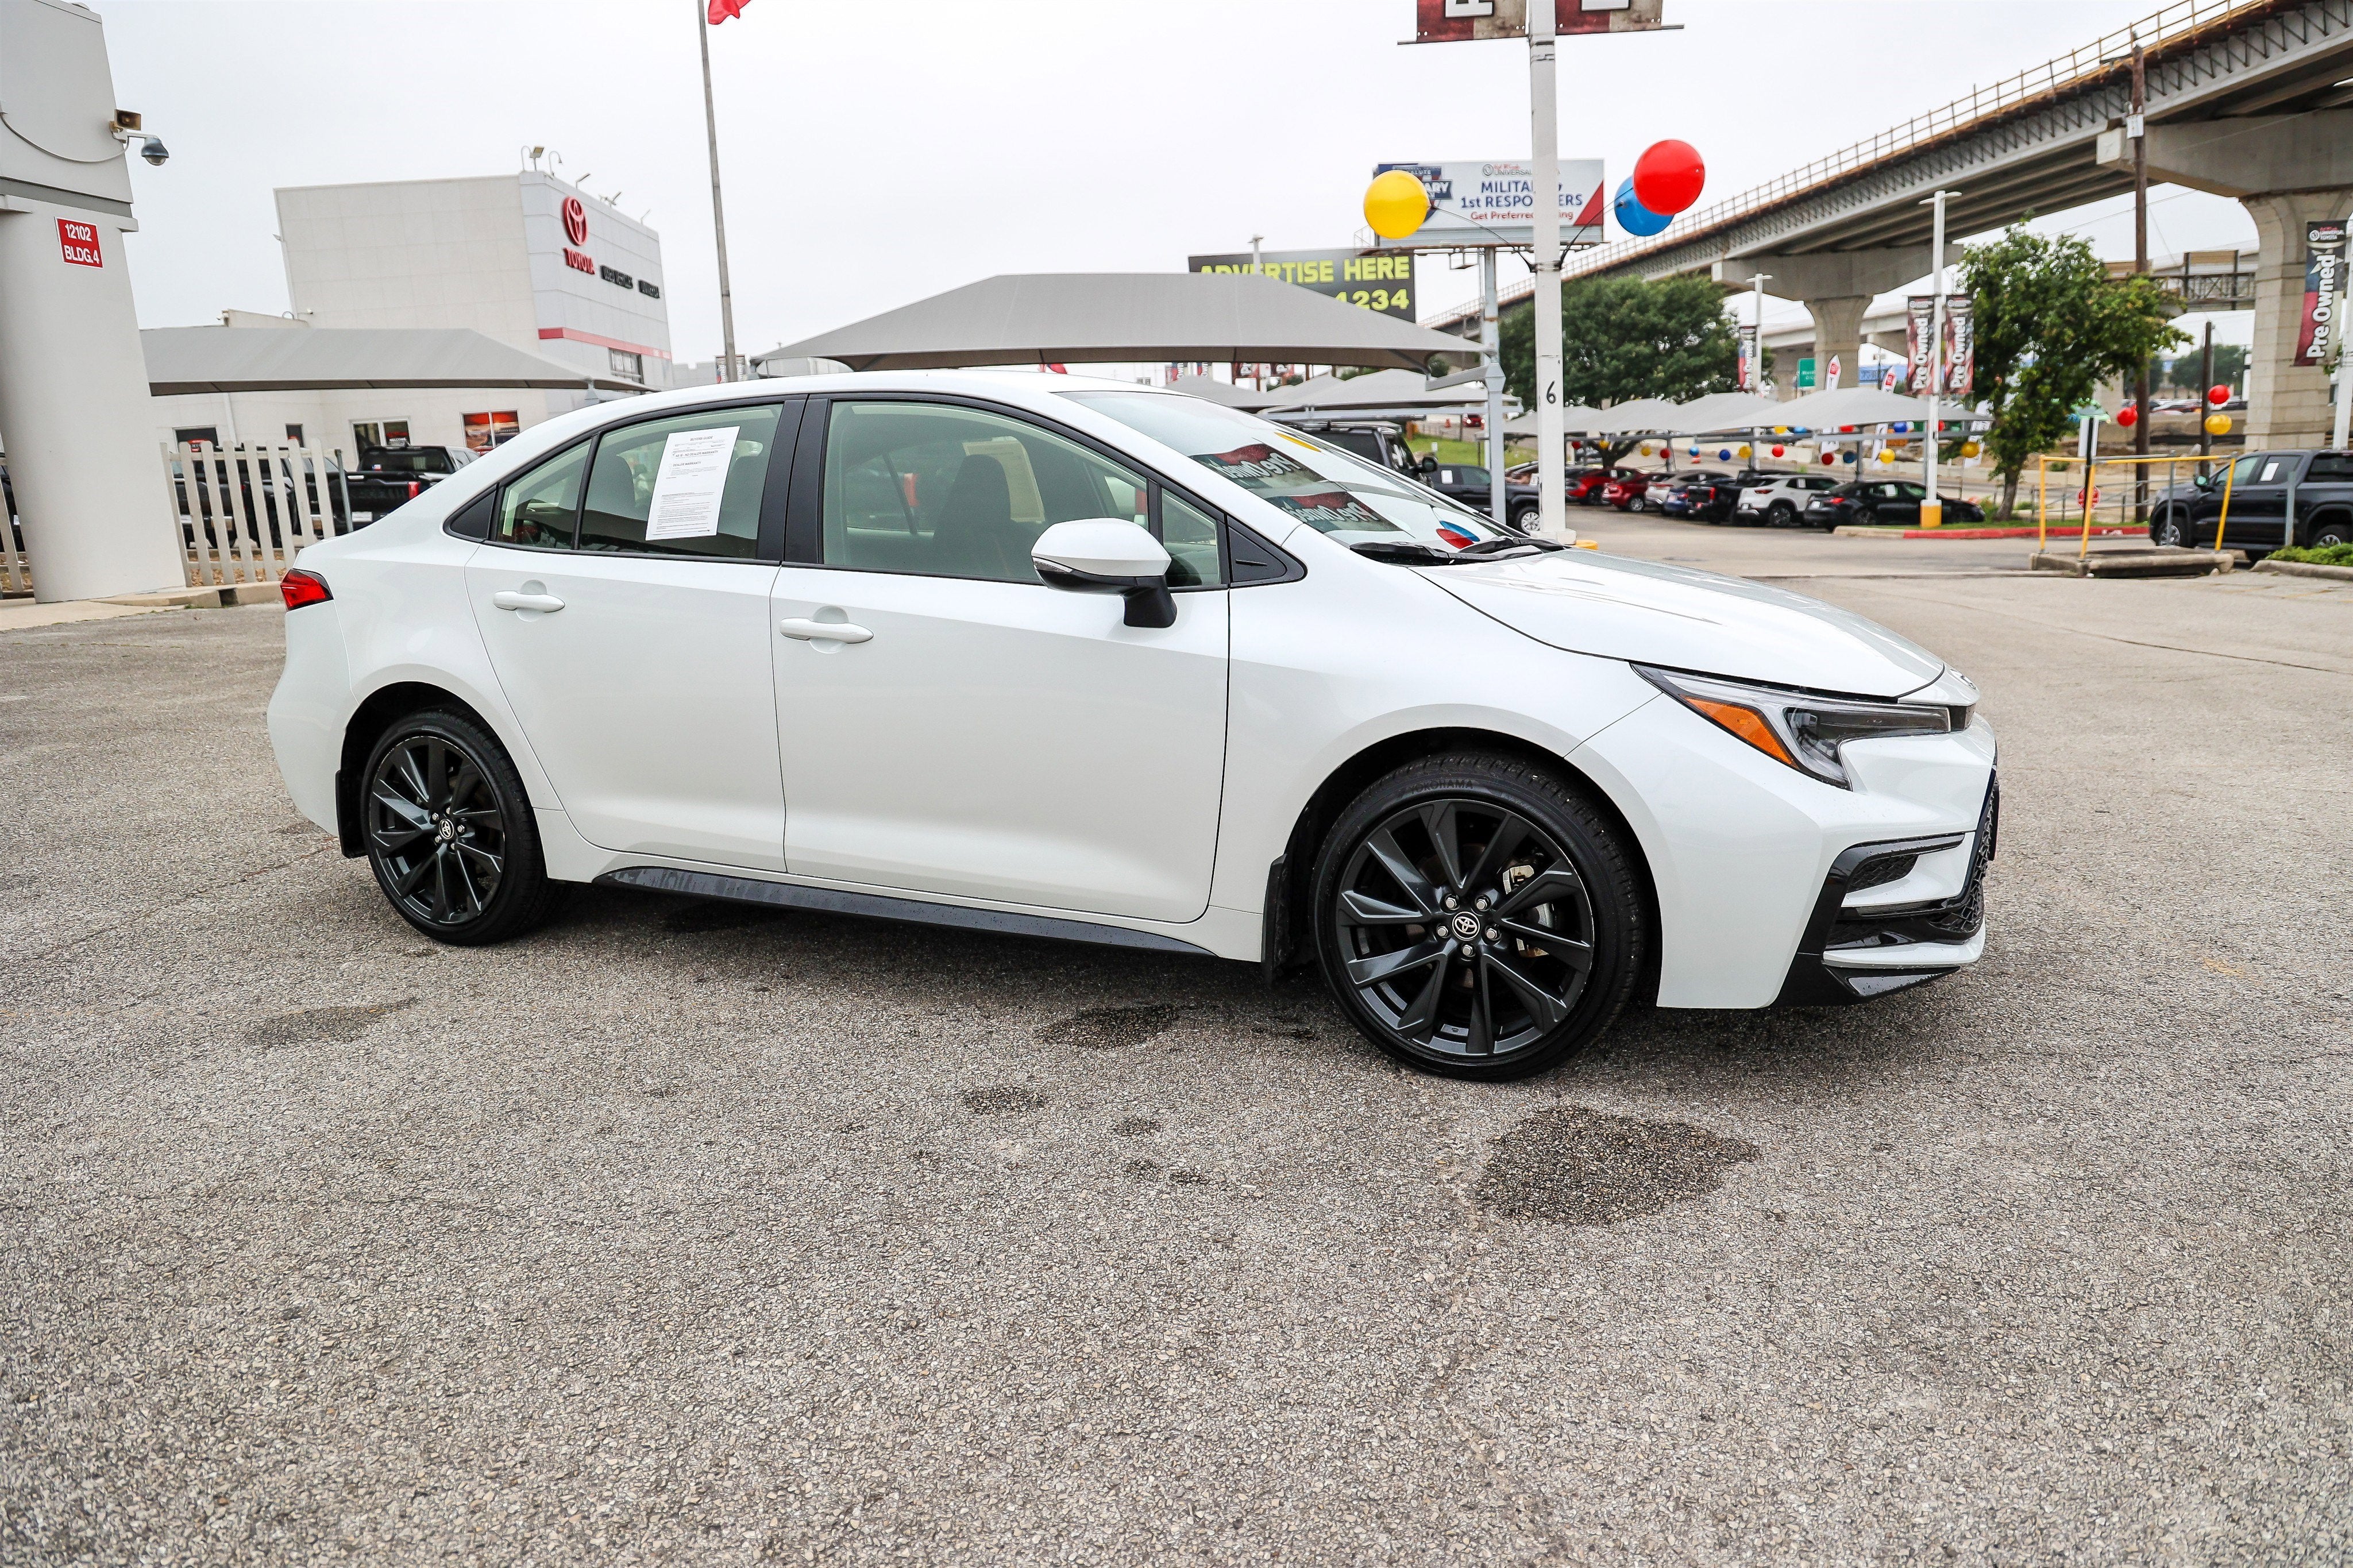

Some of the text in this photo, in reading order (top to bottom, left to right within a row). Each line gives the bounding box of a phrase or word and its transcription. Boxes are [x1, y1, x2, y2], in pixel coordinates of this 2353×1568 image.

[1481, 179, 1534, 193] MILITA
[1461, 193, 1584, 208] 1st RESPOERS
[1471, 211, 1488, 220] Get
[64, 223, 92, 242] 12102
[562, 246, 595, 275] TOYOTA
[1344, 256, 1410, 282] HERE
[2312, 254, 2336, 322] Owned
[1914, 317, 1929, 366] Owned
[1951, 316, 1966, 365] Owned
[2306, 325, 2329, 358] Pre
[1912, 366, 1928, 390] Pre
[1950, 365, 1965, 388] Pre
[1546, 380, 1556, 404] 6
[1409, 779, 1474, 795] YOKOHAMA
